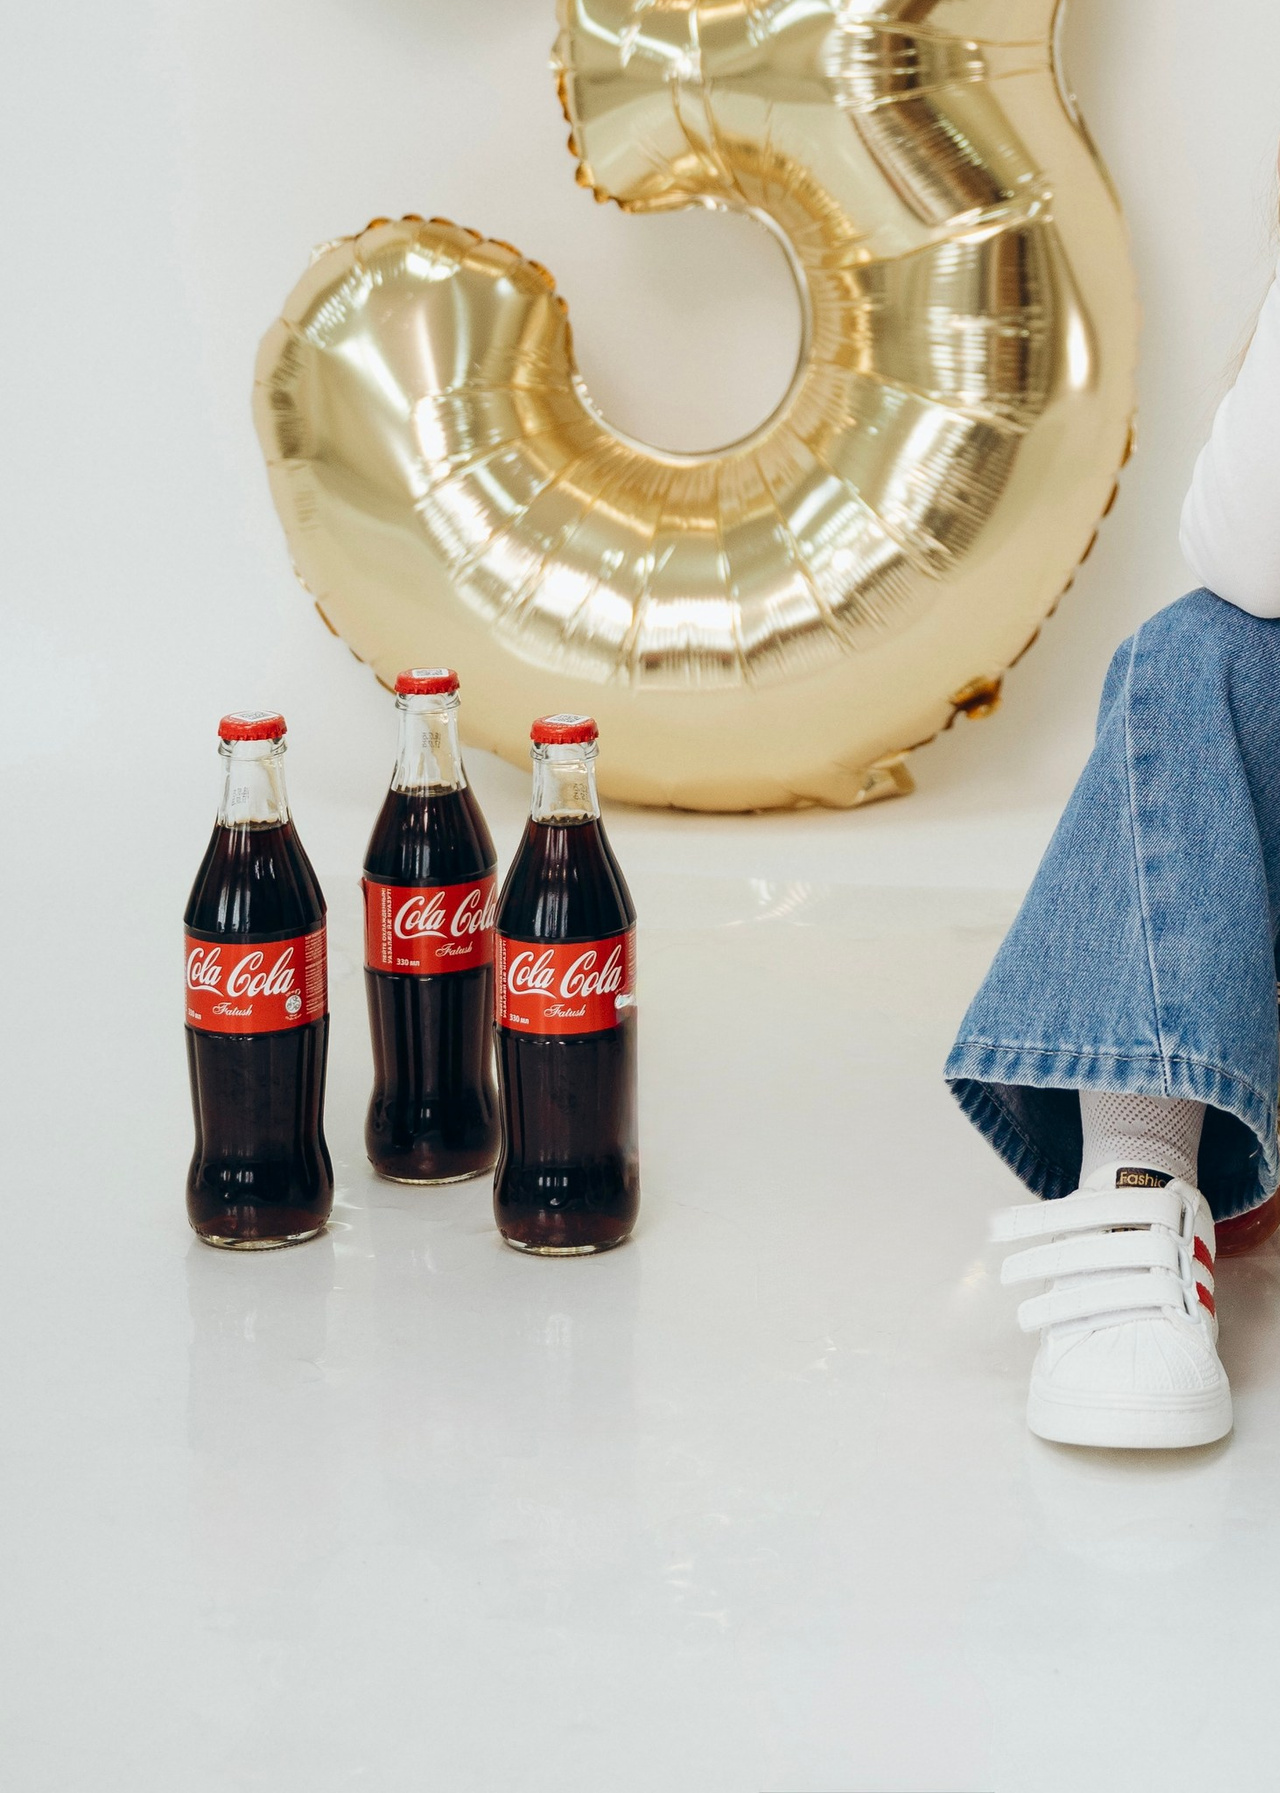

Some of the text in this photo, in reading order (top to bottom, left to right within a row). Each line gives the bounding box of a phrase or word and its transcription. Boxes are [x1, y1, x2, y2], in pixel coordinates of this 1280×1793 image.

[394, 891, 448, 939] Cola
[187, 947, 224, 997] Cola
[227, 947, 295, 997] Cola
[396, 958, 409, 966] 330
[508, 949, 557, 1000] Cola
[560, 944, 622, 998] Cola
[509, 1013, 520, 1023] 330
[1120, 1171, 1167, 1188] Fashio
